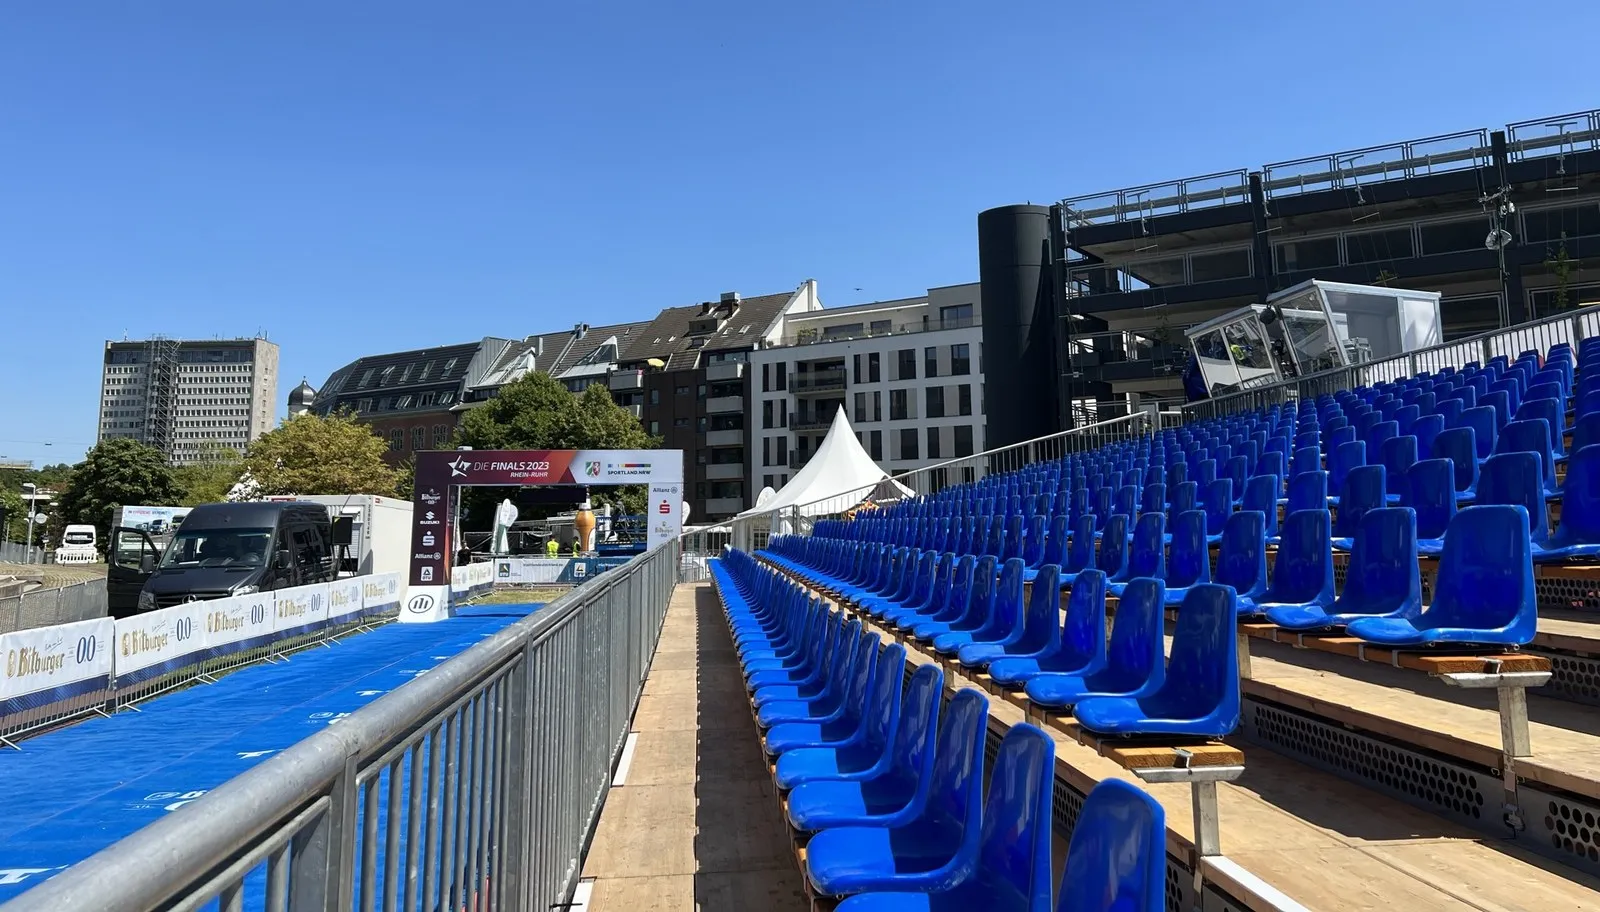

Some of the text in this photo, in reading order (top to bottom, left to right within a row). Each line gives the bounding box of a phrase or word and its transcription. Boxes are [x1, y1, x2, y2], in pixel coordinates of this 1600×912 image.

[473, 461, 550, 471] DIE FINALS 2023
[132, 628, 168, 656] Bitburger
[176, 616, 191, 642] 0.0
[214, 610, 244, 632] Bitburger
[17, 645, 65, 677] Bitburger
[76, 634, 96, 664] 0.0
